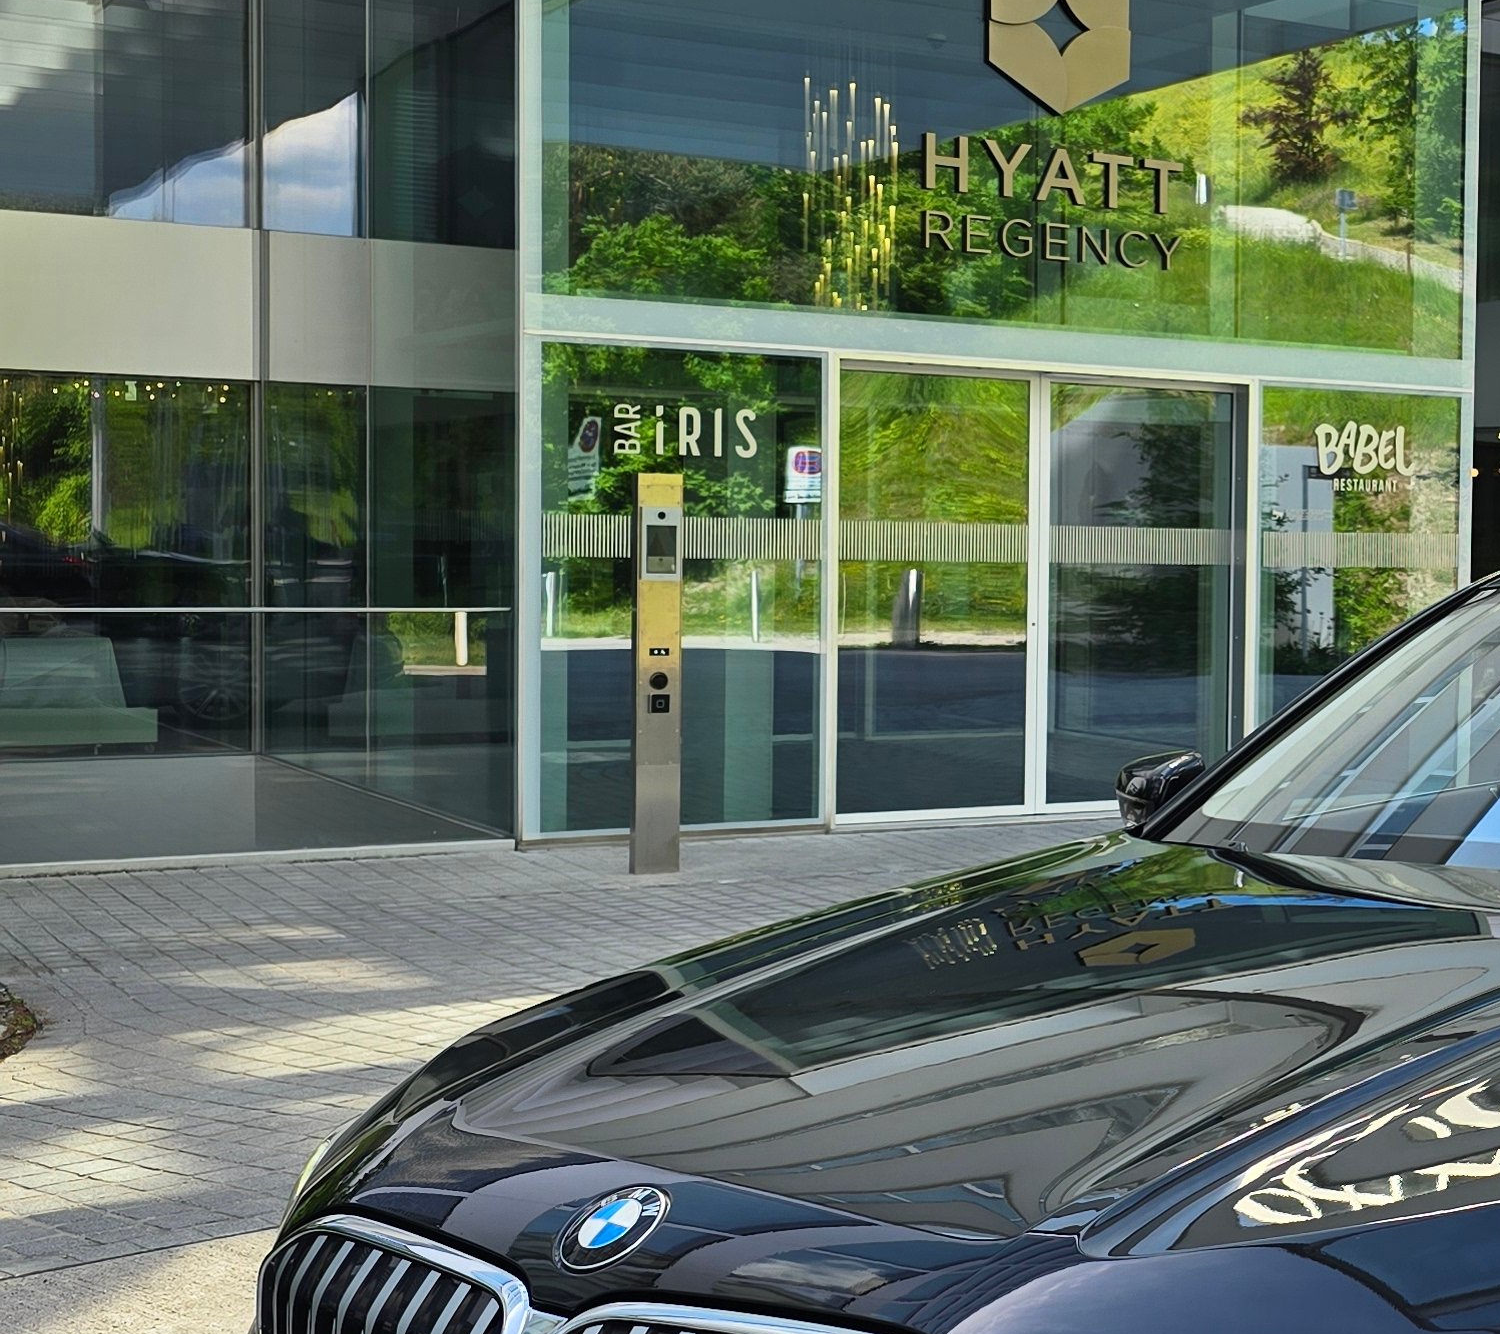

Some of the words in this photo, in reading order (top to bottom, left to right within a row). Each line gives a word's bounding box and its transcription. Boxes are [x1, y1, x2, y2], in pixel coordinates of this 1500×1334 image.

[921, 132, 1184, 214] HYATT
[922, 210, 1182, 271] REGENCY
[613, 403, 641, 455] BAR
[1333, 478, 1398, 493] RESTAURANT
